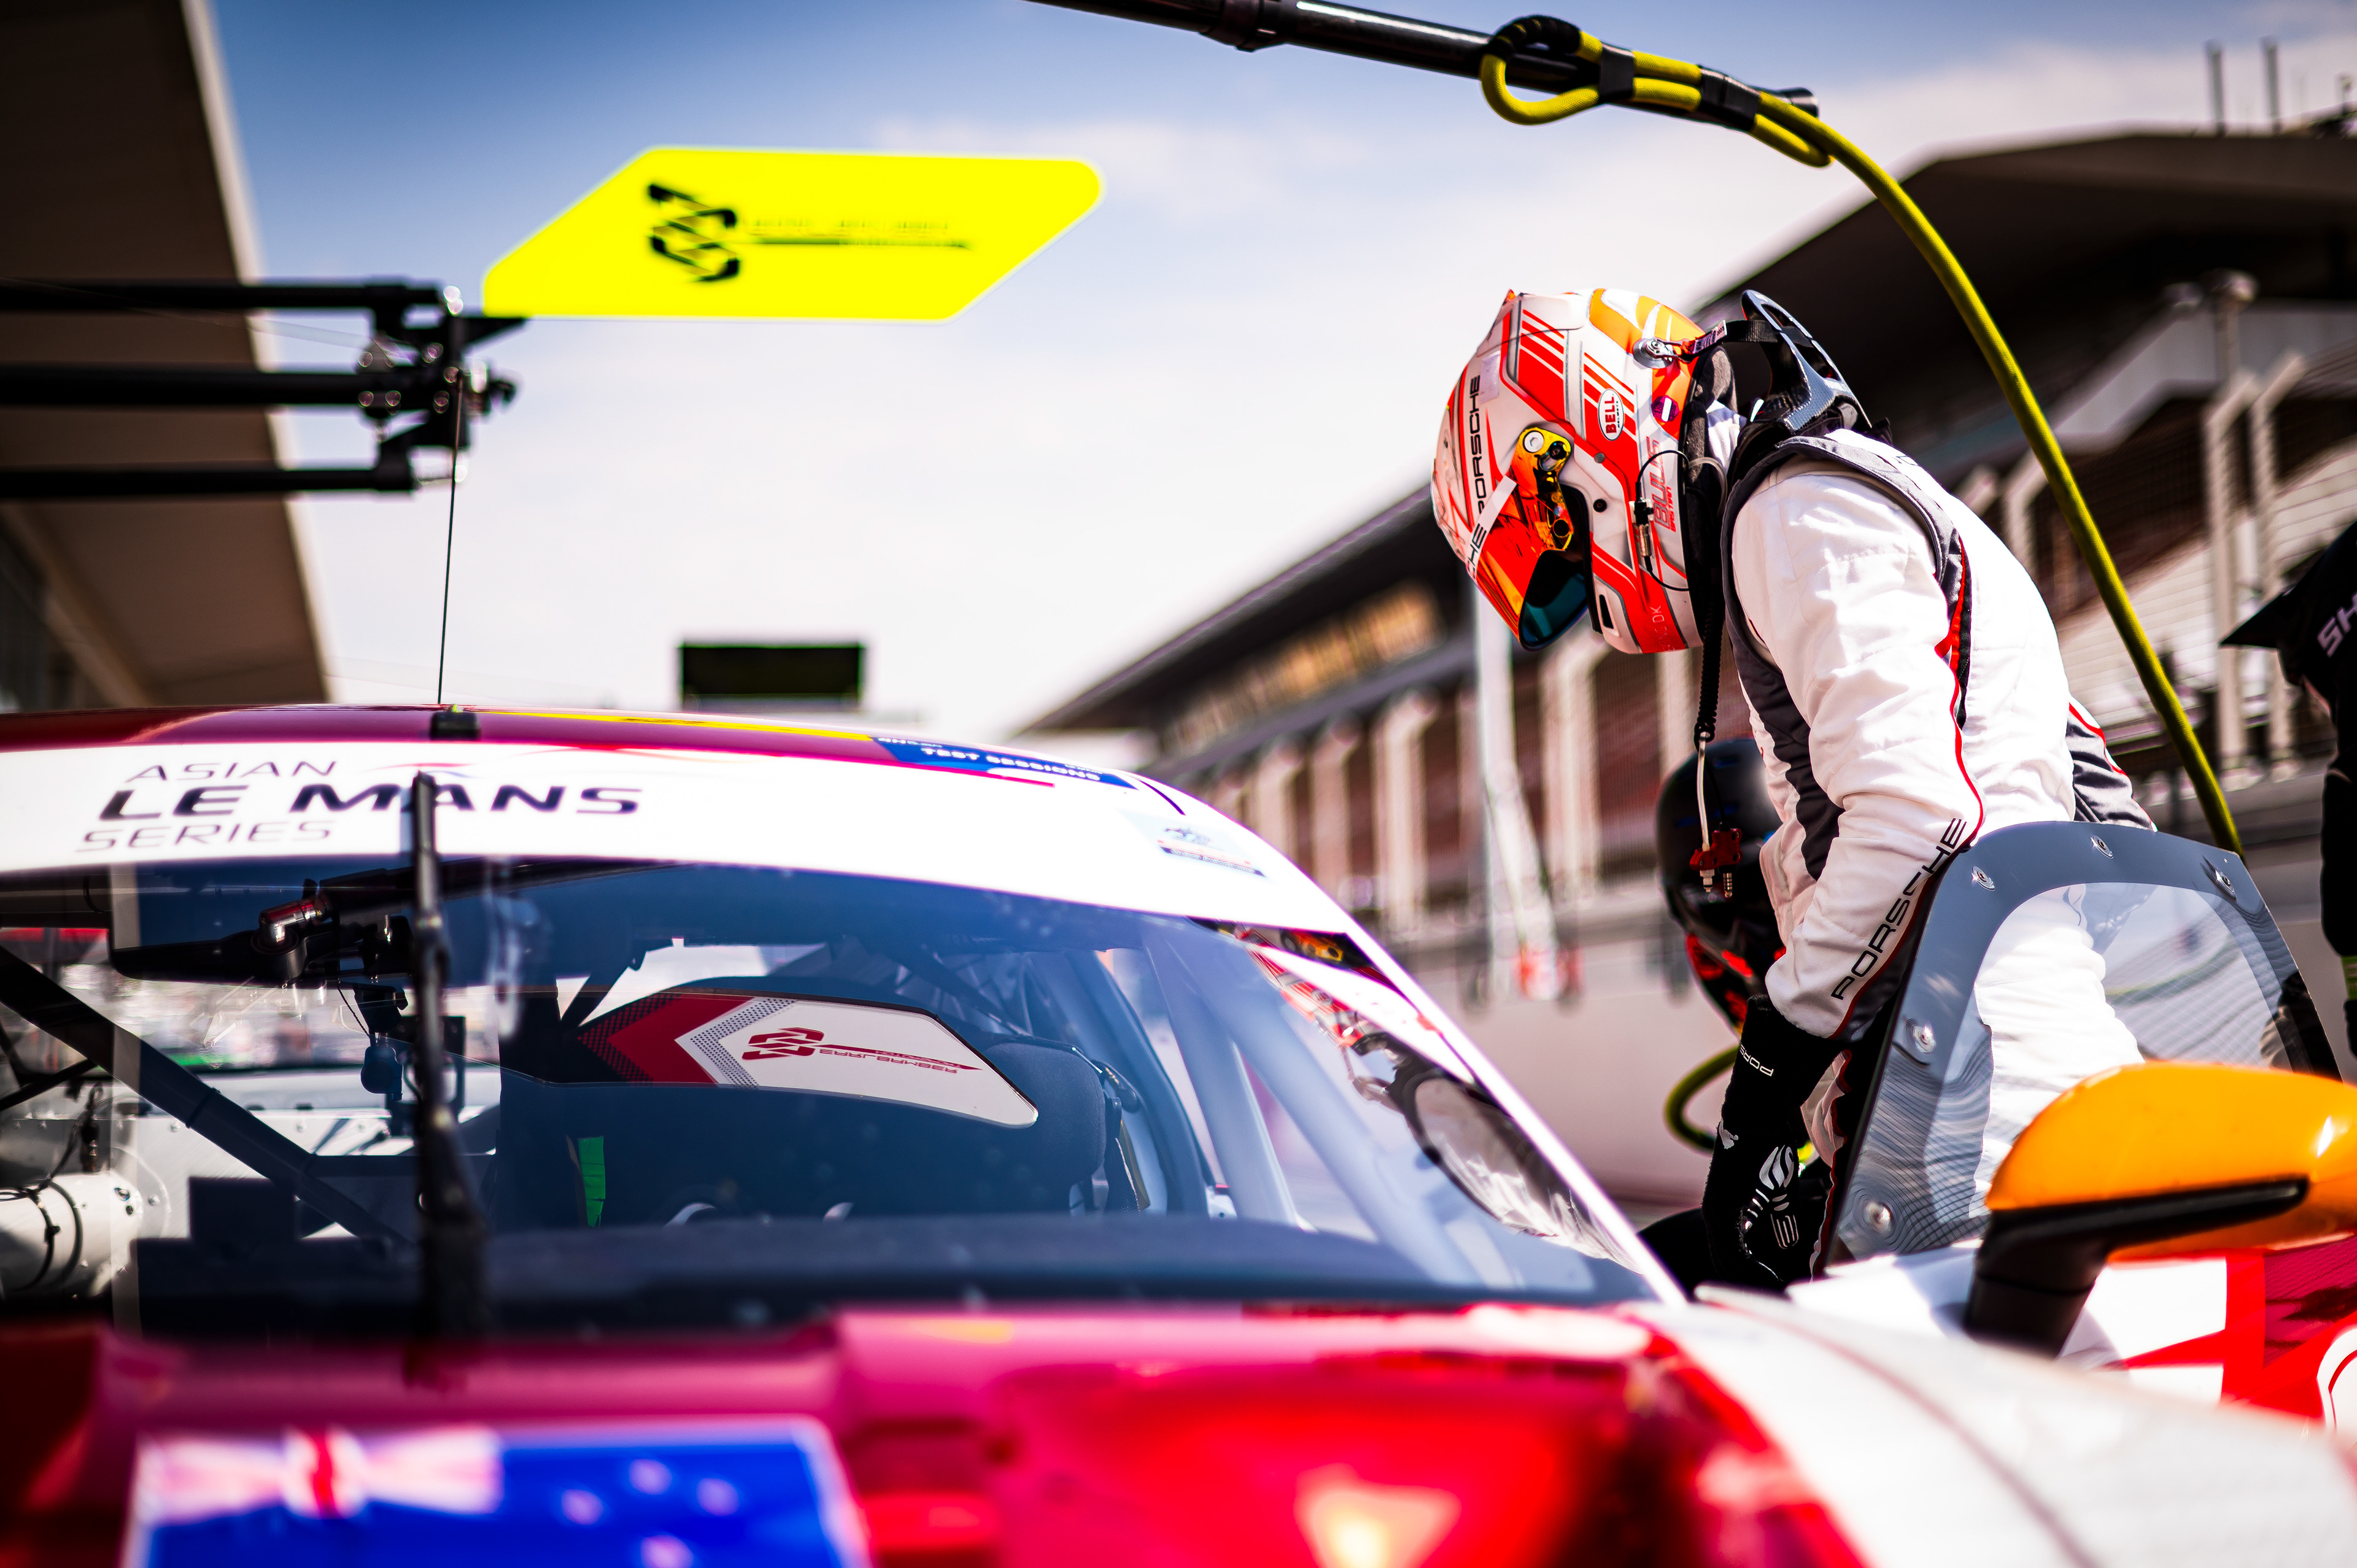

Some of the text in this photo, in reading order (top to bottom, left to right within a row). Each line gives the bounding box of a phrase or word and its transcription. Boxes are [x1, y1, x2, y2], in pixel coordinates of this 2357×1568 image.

[1604, 396, 1617, 434] BELL
[125, 760, 338, 783] ASIAN
[921, 747, 980, 760] TEST
[986, 755, 1101, 781] SESSIONS
[98, 782, 643, 821] LE MANS
[75, 821, 333, 853] SERIES
[1831, 817, 1967, 1000] PORSCHE
